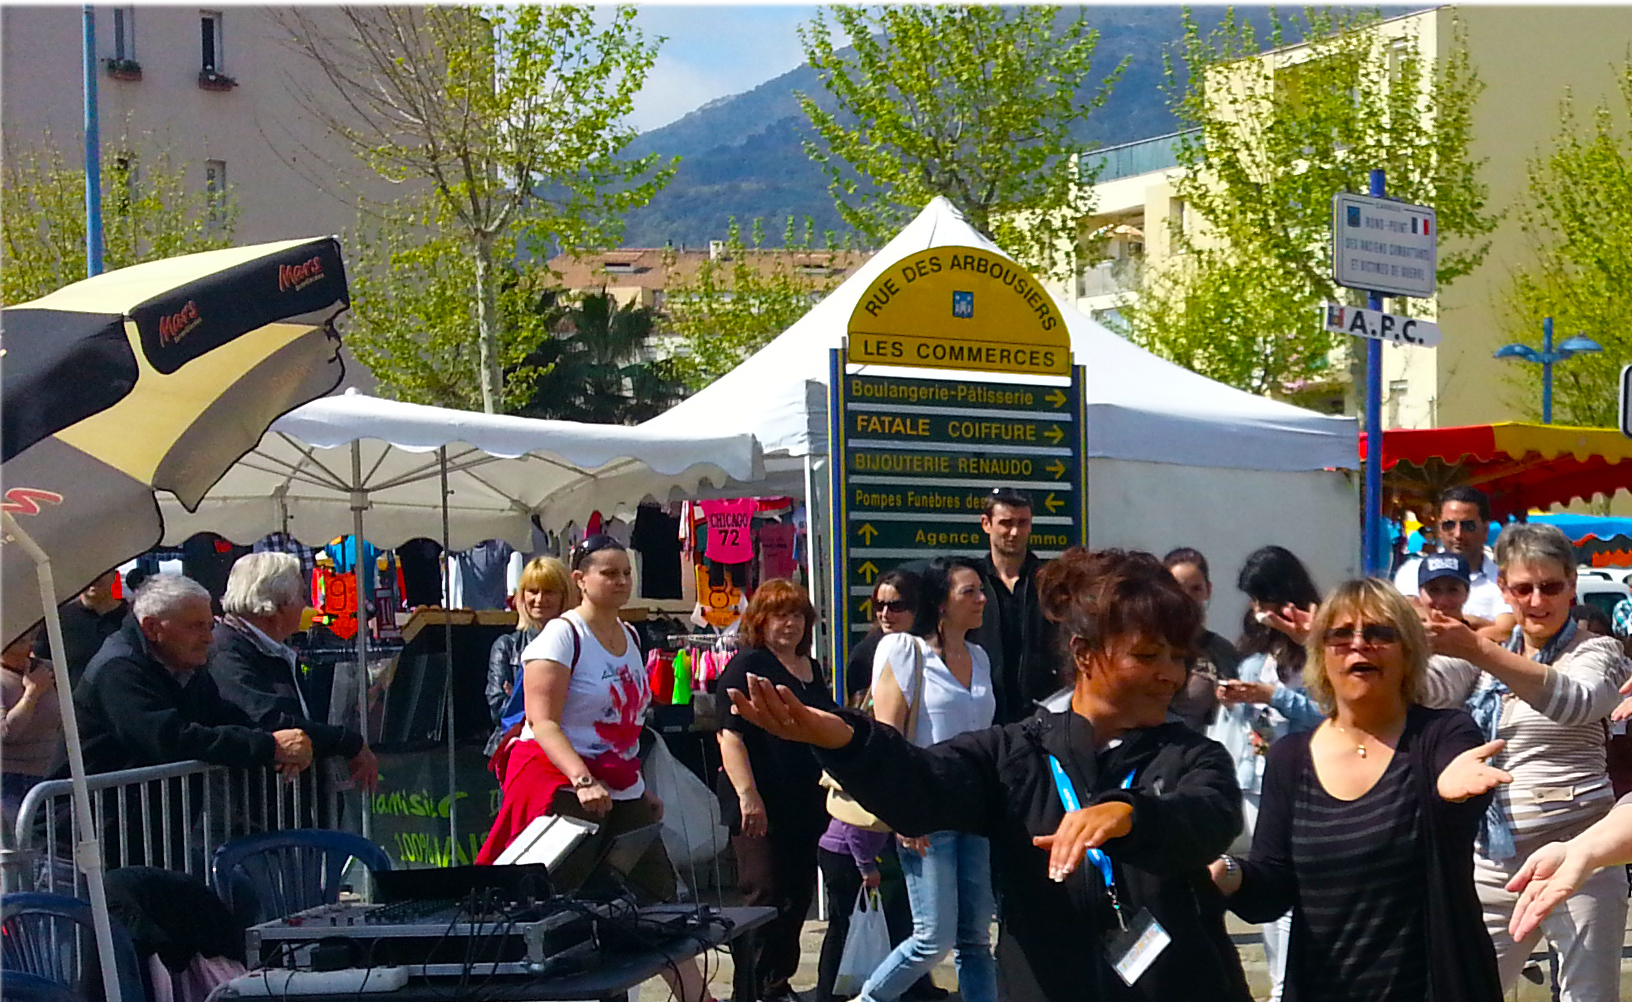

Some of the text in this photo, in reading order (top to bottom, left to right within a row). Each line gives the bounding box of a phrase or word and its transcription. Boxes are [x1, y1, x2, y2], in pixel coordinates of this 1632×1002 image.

[278, 256, 322, 292] Mars
[865, 254, 1057, 331] RUE DES ARBOUSIERS
[159, 300, 201, 348] Mars
[864, 339, 1055, 367] LES COMMERCES
[851, 379, 1034, 406] Boulangerie-Pâtisserie
[857, 415, 1036, 441] FATALE COIFFURE
[855, 453, 1033, 476] BIJOUTERIE RENAUDO
[855, 489, 987, 510] Pompes Funèbres des
[710, 513, 748, 528] CHICAGO
[718, 529, 740, 546] 72
[915, 529, 1068, 545] Agence mmo
[330, 578, 347, 611] 9
